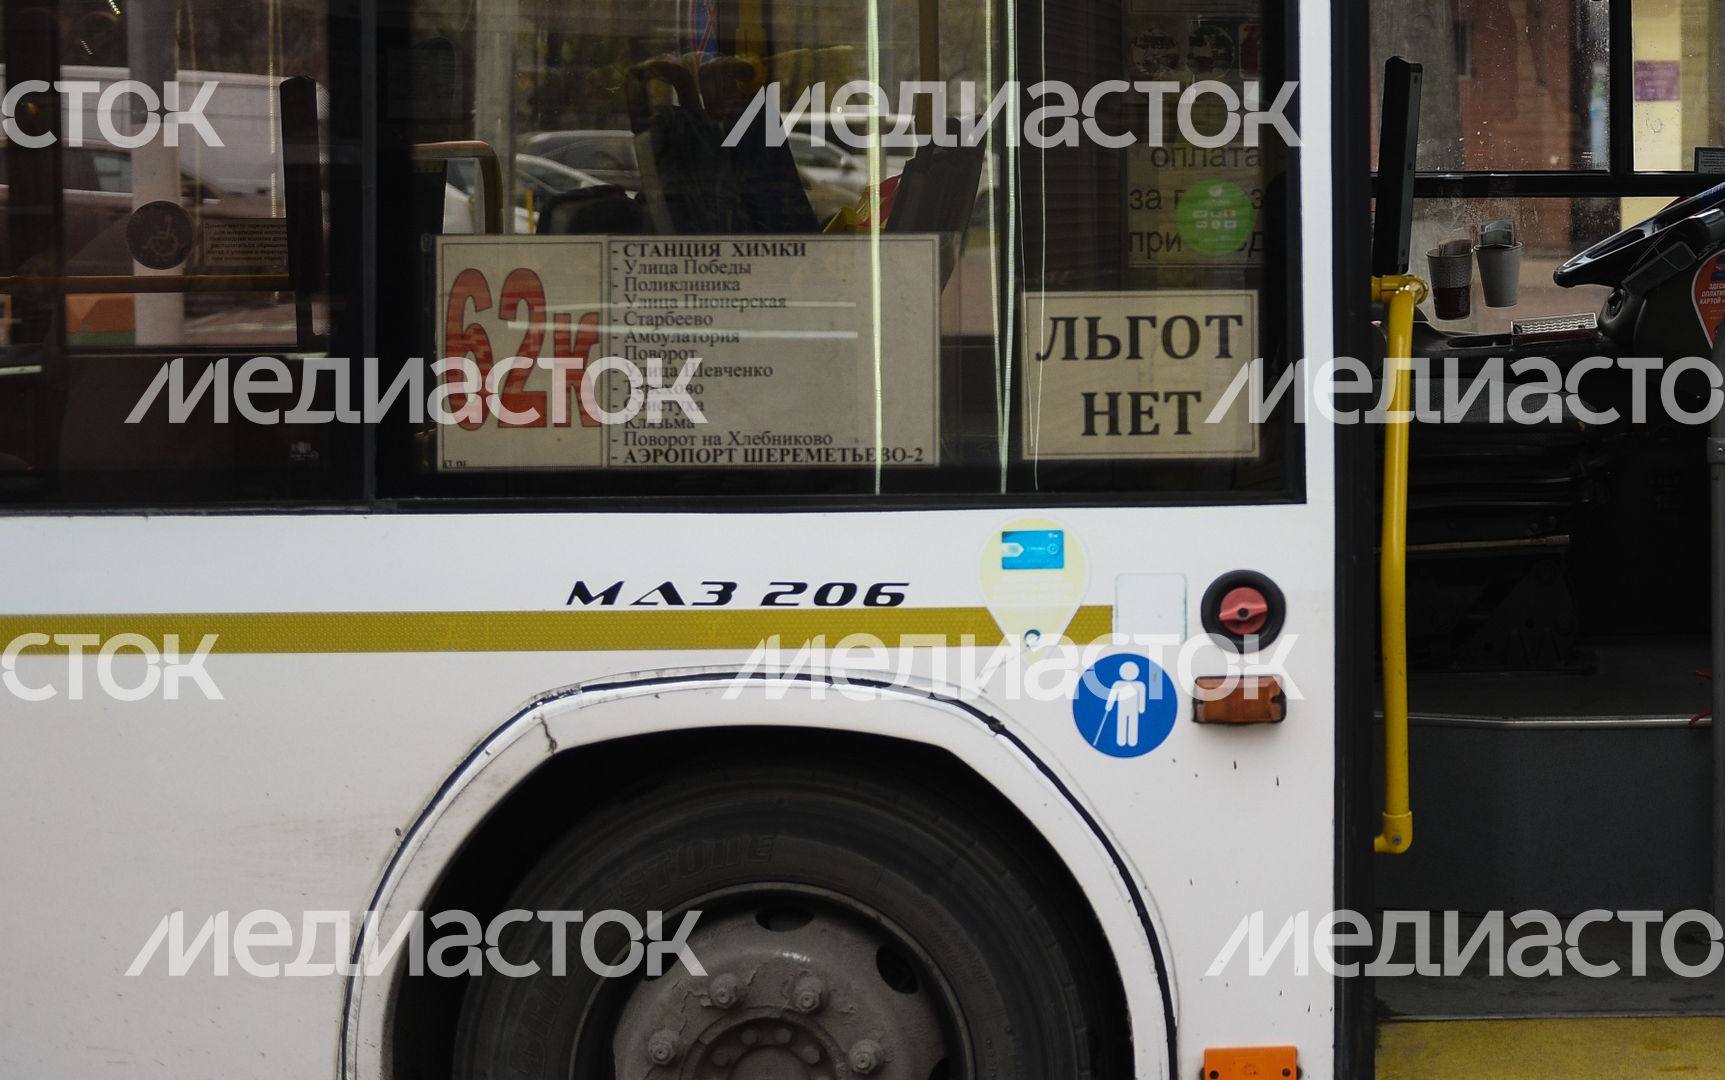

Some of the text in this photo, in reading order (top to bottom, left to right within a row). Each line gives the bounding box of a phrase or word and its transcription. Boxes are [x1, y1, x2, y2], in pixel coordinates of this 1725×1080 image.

[1151, 146, 1263, 169] оплата
[1129, 189, 1163, 211] за
[623, 242, 807, 259] СТАНЦИЯ ХИМКИ
[623, 259, 752, 275] Улица Победы
[623, 276, 741, 292] Поликлиника
[623, 293, 787, 312] Улица Пионерская
[623, 311, 714, 328] Старбеево
[1035, 314, 1244, 362] ЛЬГОТ
[623, 345, 698, 363] Поворот
[684, 362, 774, 378] Шевченко
[623, 414, 696, 430] Клязьма
[1081, 390, 1202, 437] НЕТ
[623, 431, 833, 448] Поворот на Хлебниково
[623, 448, 737, 464] АЭРОПОРТ
[565, 580, 911, 608] МАЗ 206
